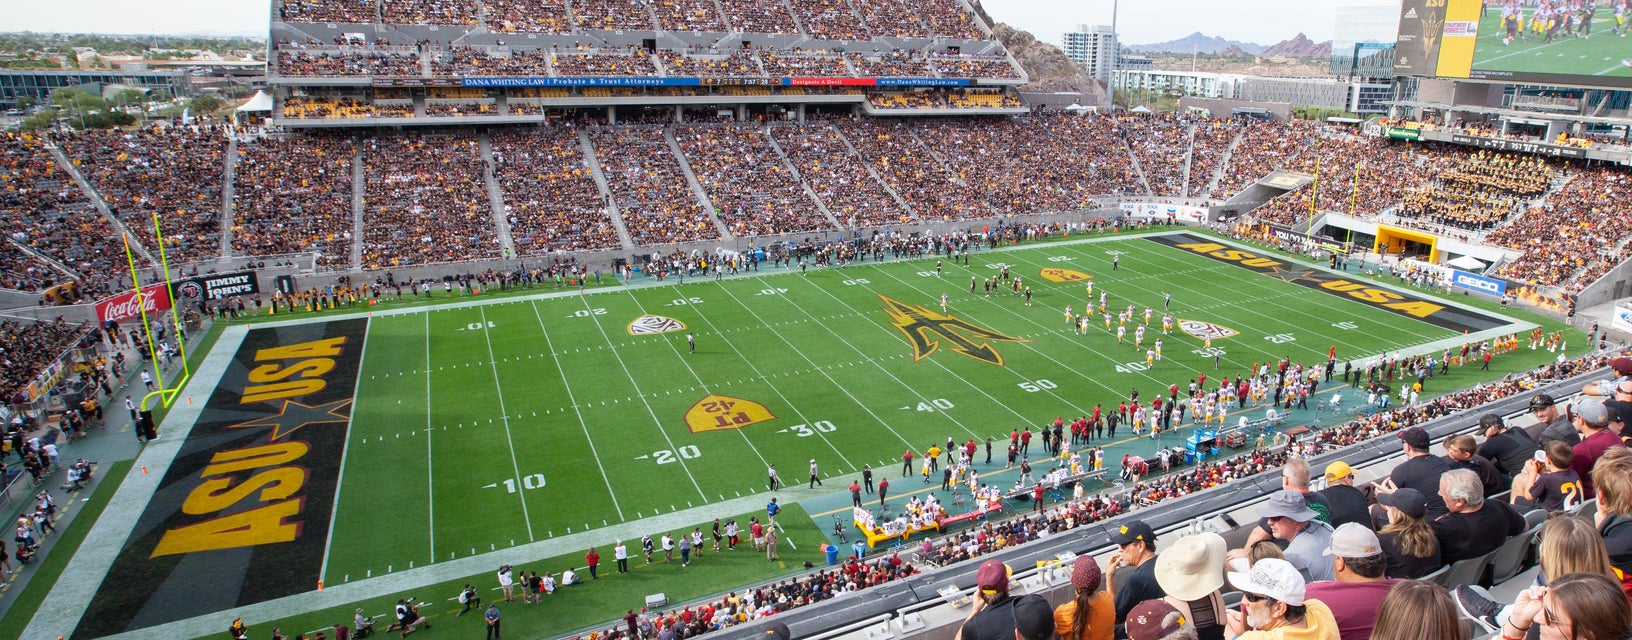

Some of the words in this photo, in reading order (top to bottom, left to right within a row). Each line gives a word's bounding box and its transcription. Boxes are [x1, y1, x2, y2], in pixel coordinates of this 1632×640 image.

[1275, 230, 1289, 240] YOU
[205, 275, 249, 290] JIMMY
[1176, 242, 1282, 268] ASU
[1320, 280, 1447, 318] USA
[1458, 275, 1498, 292] GEICO
[208, 284, 252, 300] JOHN'S
[672, 297, 704, 306] 30
[574, 308, 607, 317] 20
[468, 321, 496, 330] 10
[1115, 362, 1148, 374] 40
[1017, 379, 1058, 393] 50
[700, 400, 735, 413] 42
[915, 398, 954, 412] 40
[715, 412, 752, 428] PT
[790, 420, 837, 438] 30
[149, 440, 312, 559] ASU
[240, 336, 348, 404] USA
[652, 444, 702, 464] 20
[503, 473, 546, 494] 10
[1561, 480, 1584, 511] 21
